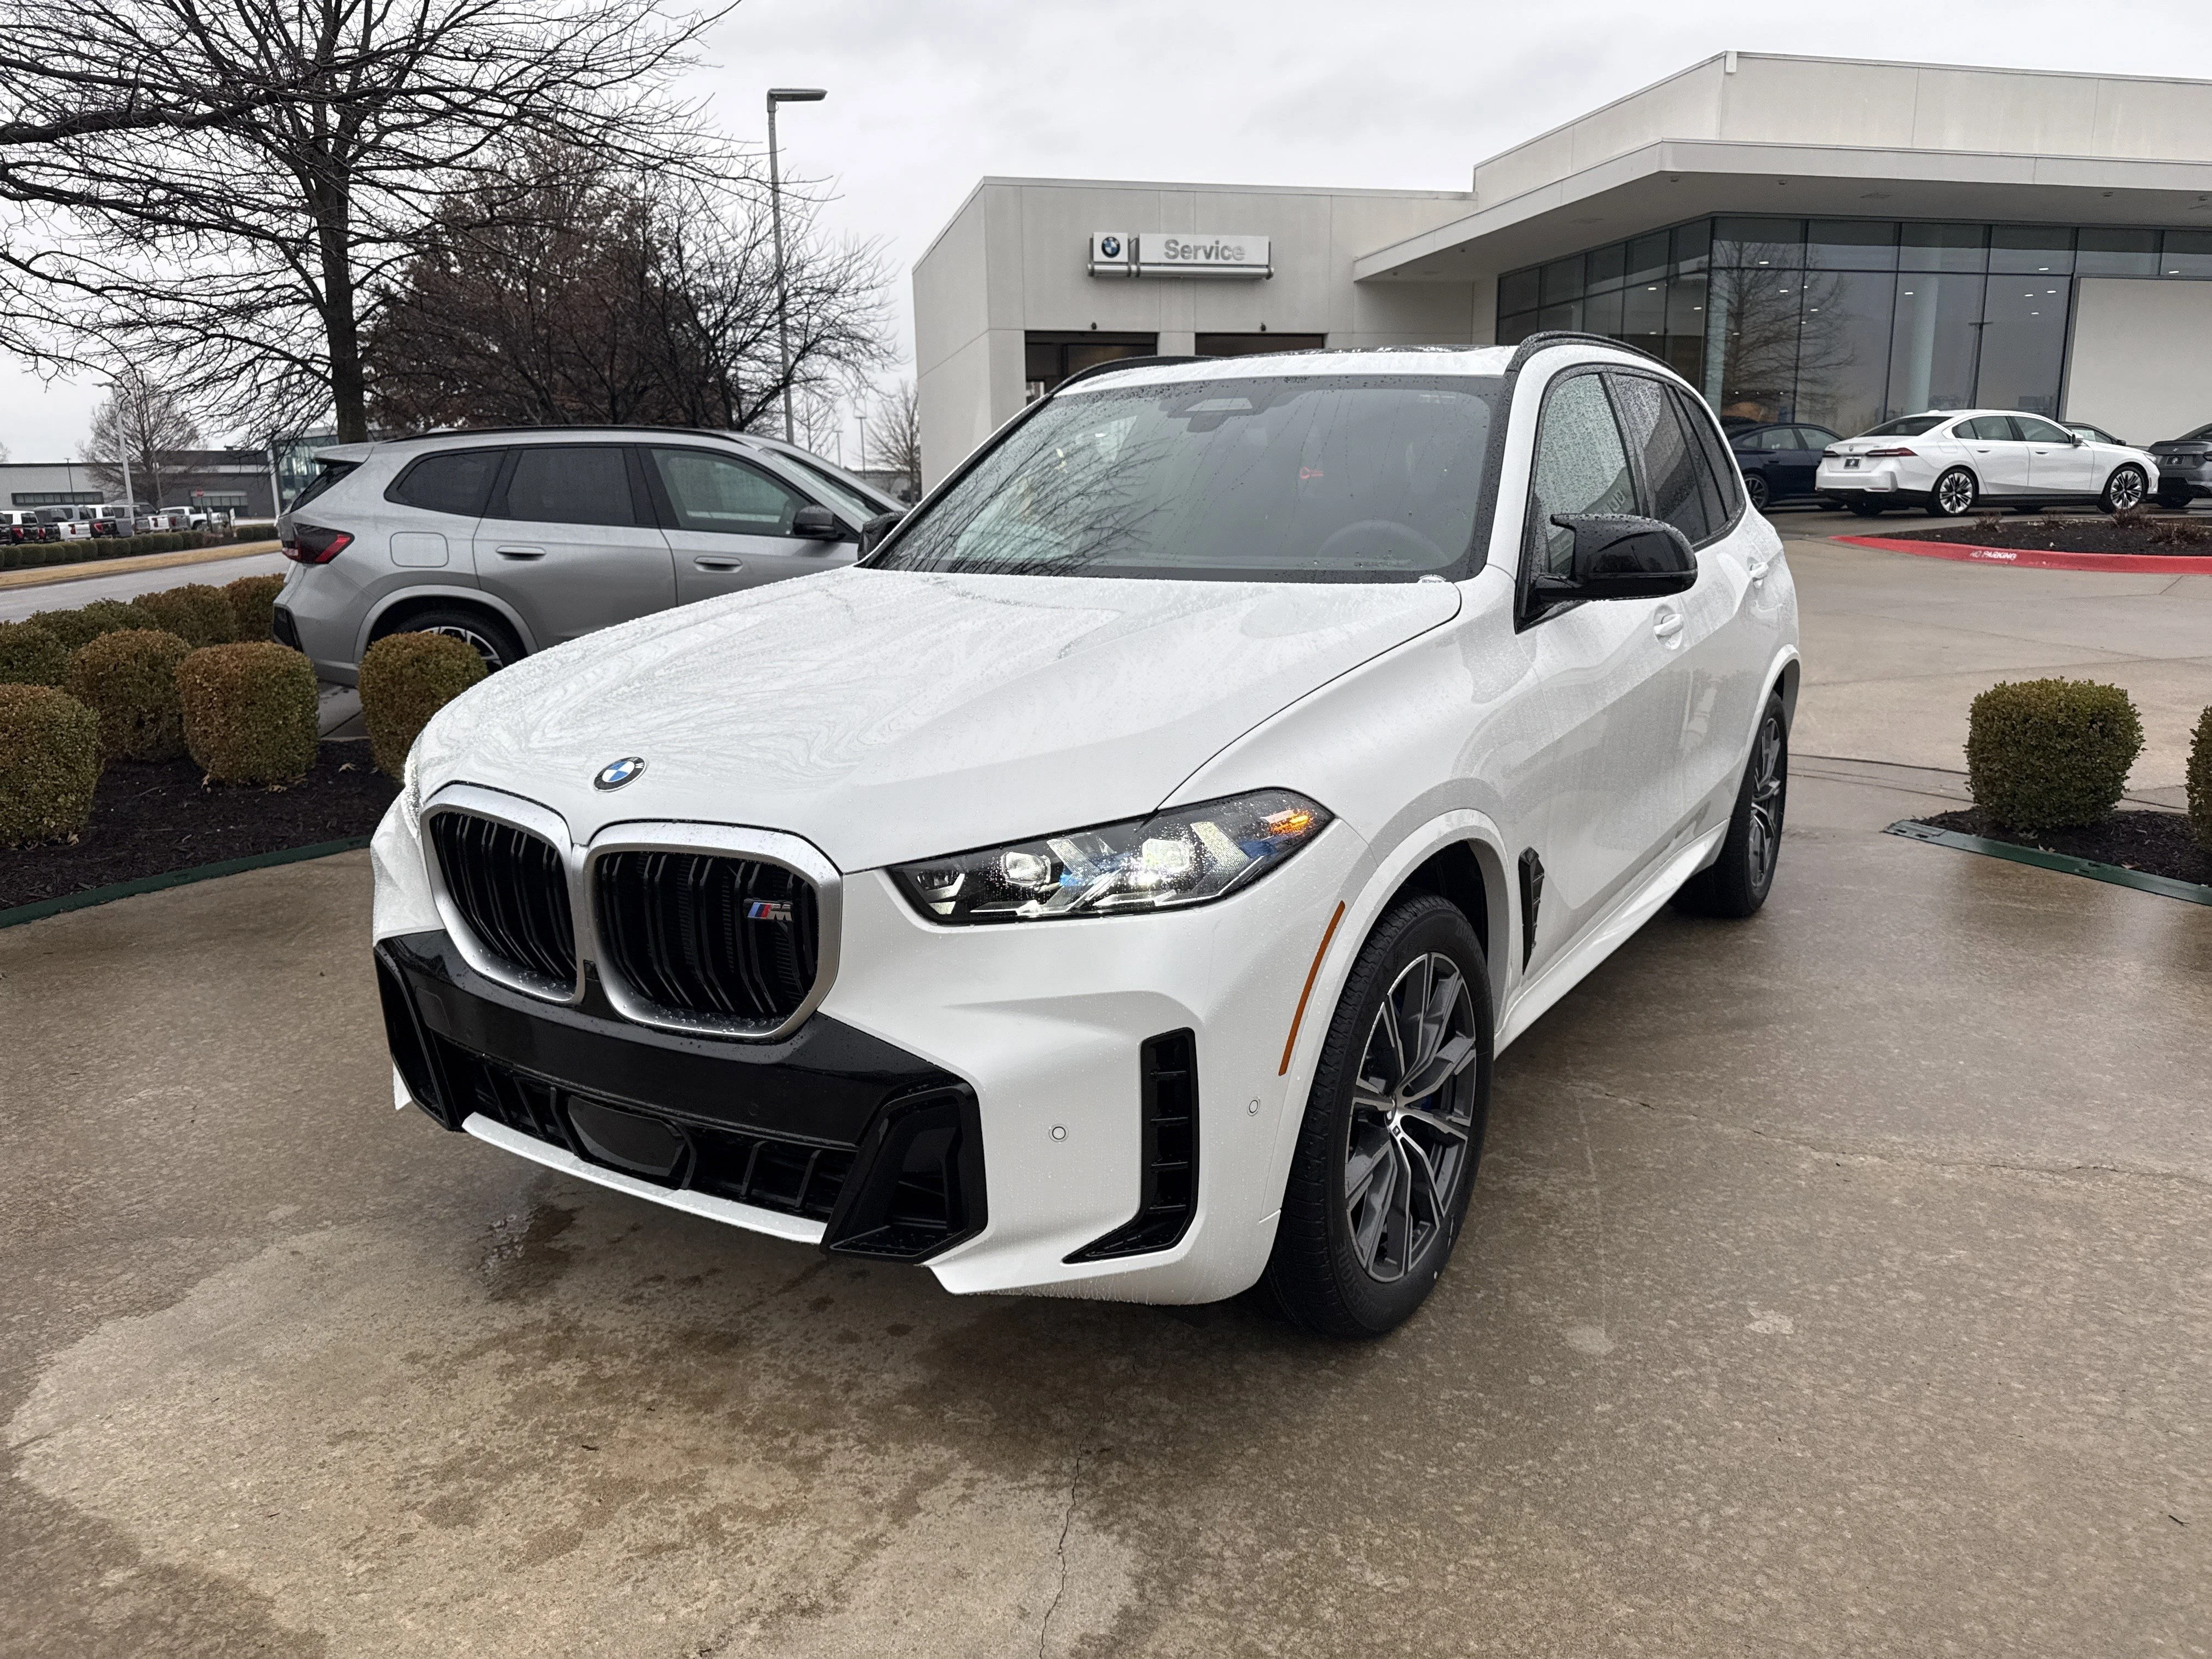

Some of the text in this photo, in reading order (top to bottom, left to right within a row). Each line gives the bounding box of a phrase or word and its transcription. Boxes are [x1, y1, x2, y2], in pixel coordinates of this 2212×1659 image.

[1164, 239, 1245, 261] Service
[1982, 551, 2017, 560] PARKING
[766, 904, 793, 922] M
